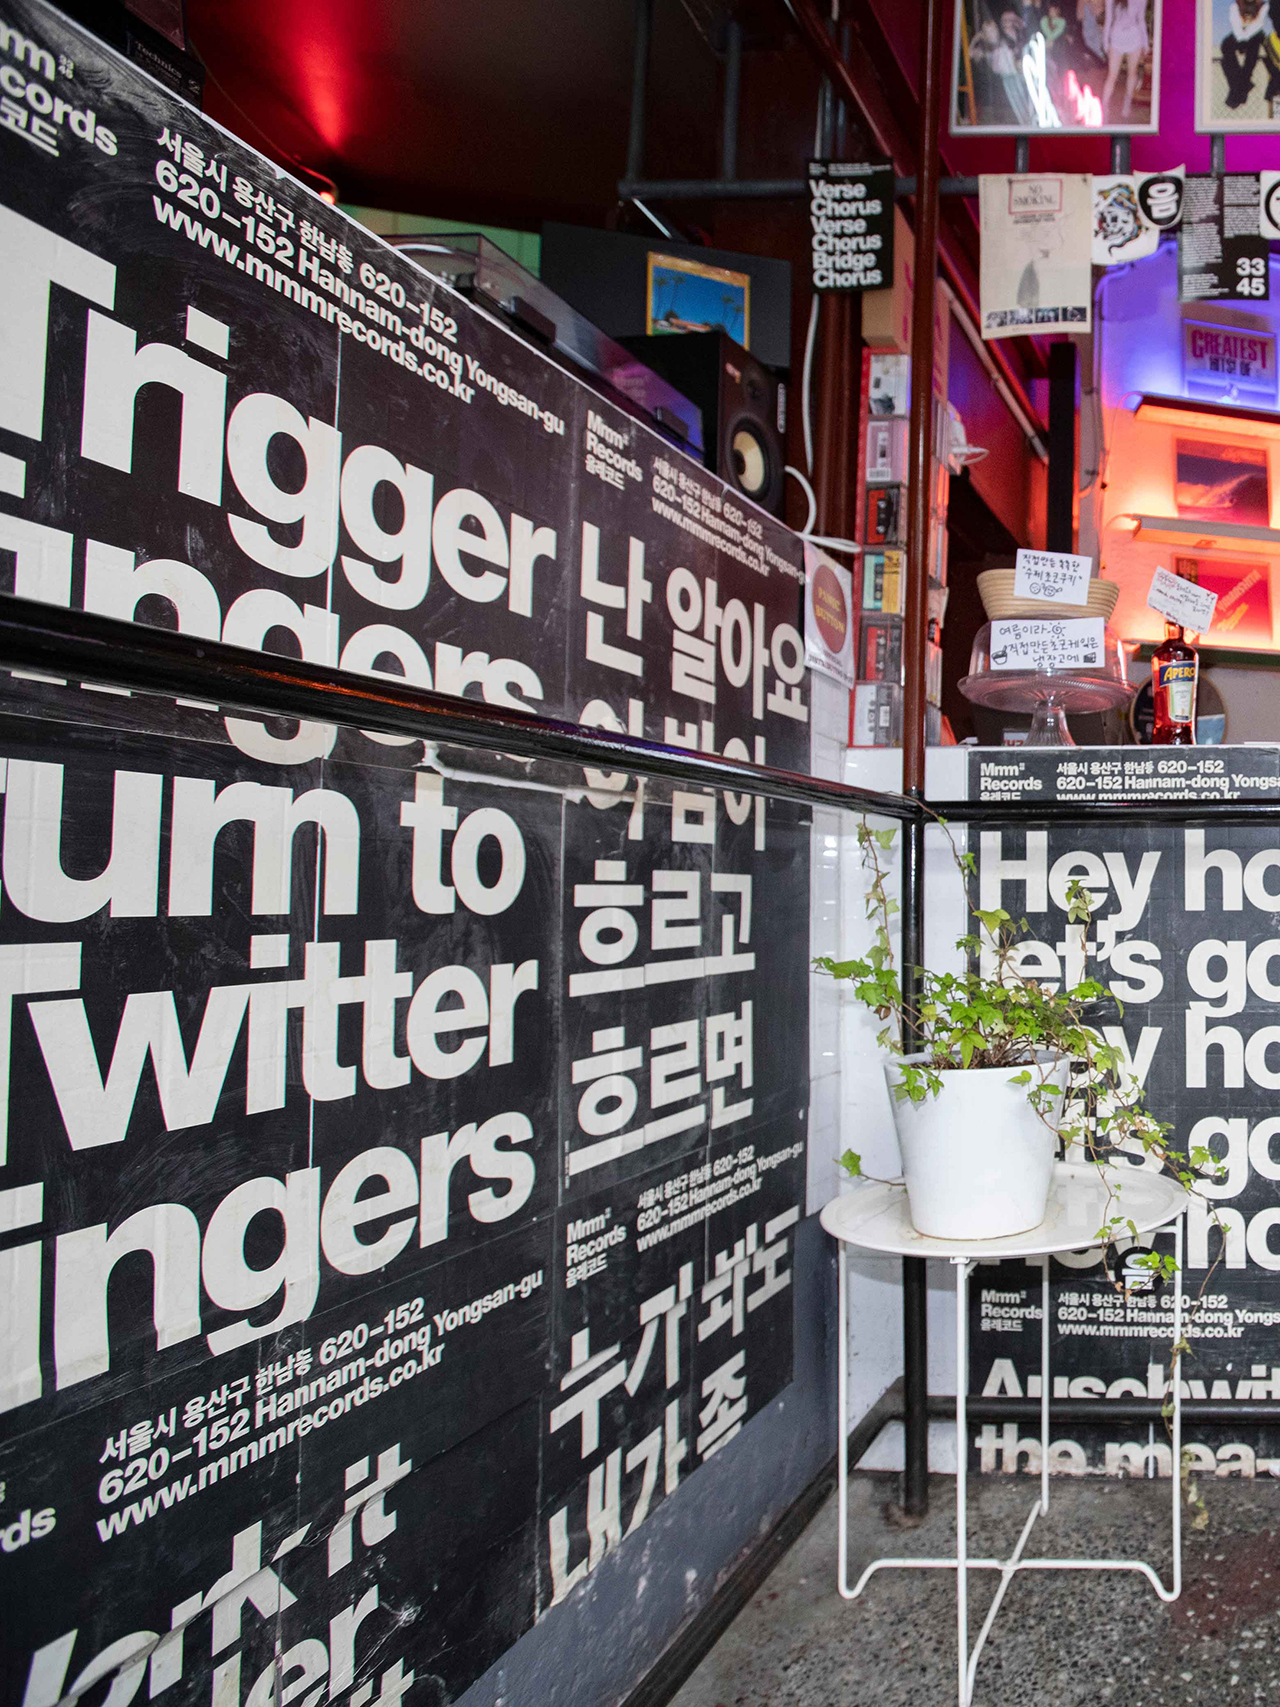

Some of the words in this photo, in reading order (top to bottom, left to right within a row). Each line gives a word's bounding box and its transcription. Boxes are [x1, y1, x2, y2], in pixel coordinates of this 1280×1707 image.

[809, 180, 867, 199] Verse
[811, 197, 882, 216] Chorus
[157, 127, 228, 193] 서울시
[232, 176, 297, 233] 용산구
[299, 219, 355, 275] 한남동
[359, 262, 458, 344] 620-152
[810, 215, 867, 234] Verse
[812, 233, 883, 251] Chorus
[812, 251, 877, 271] Bridge
[813, 268, 883, 288] Chorus
[1236, 257, 1266, 276] 33
[152, 193, 476, 404] www.mmmrecords.co.kr
[155, 159, 296, 269] 620-152
[298, 246, 464, 377] Hannam-dong
[464, 353, 566, 436] Yongsan-gu
[1236, 277, 1266, 296] 45
[585, 454, 626, 491] 음레코드
[586, 428, 644, 483] Records
[651, 497, 771, 578] www.mmmrecords.co.kr
[0, 450, 545, 766] ingers
[580, 520, 652, 677] 난
[666, 566, 809, 722] 알아요
[980, 777, 1043, 791] Records
[1056, 763, 1088, 775] 서울시
[1090, 763, 1122, 776] 용산구
[1124, 761, 1154, 775] 한남동
[1158, 760, 1225, 773] 620-152
[1056, 776, 1123, 790] 620-152
[1124, 775, 1229, 794] Hannam-dong
[0, 757, 361, 922] urn
[400, 771, 527, 916] to
[980, 830, 1161, 932] Hey
[569, 859, 756, 998] 흐르고
[568, 1000, 754, 1177] 흐르면
[636, 1191, 689, 1232] 620-152
[688, 1162, 757, 1208] Hannam-dong
[636, 1176, 763, 1253] www.mmmrecords.co.kr
[566, 1224, 627, 1267] Records
[566, 1253, 608, 1289] 음레코드
[981, 1305, 1043, 1320] Records
[1058, 1293, 1089, 1306] 서울시
[1058, 1308, 1124, 1322] 620-152
[980, 1319, 1023, 1332] 음레코드
[98, 1406, 178, 1465] 서울시
[182, 1375, 252, 1428] 용산구
[255, 1347, 314, 1396] 한남동
[319, 1297, 425, 1367] 620-152
[550, 1261, 693, 1460] 누가
[98, 1409, 252, 1506] 620-152
[253, 1324, 433, 1430] Hannam-dong
[432, 1269, 545, 1333] Yongsan-gu
[96, 1342, 446, 1543] www.mmmrecords.co.kr
[549, 1398, 688, 1608] 내가
